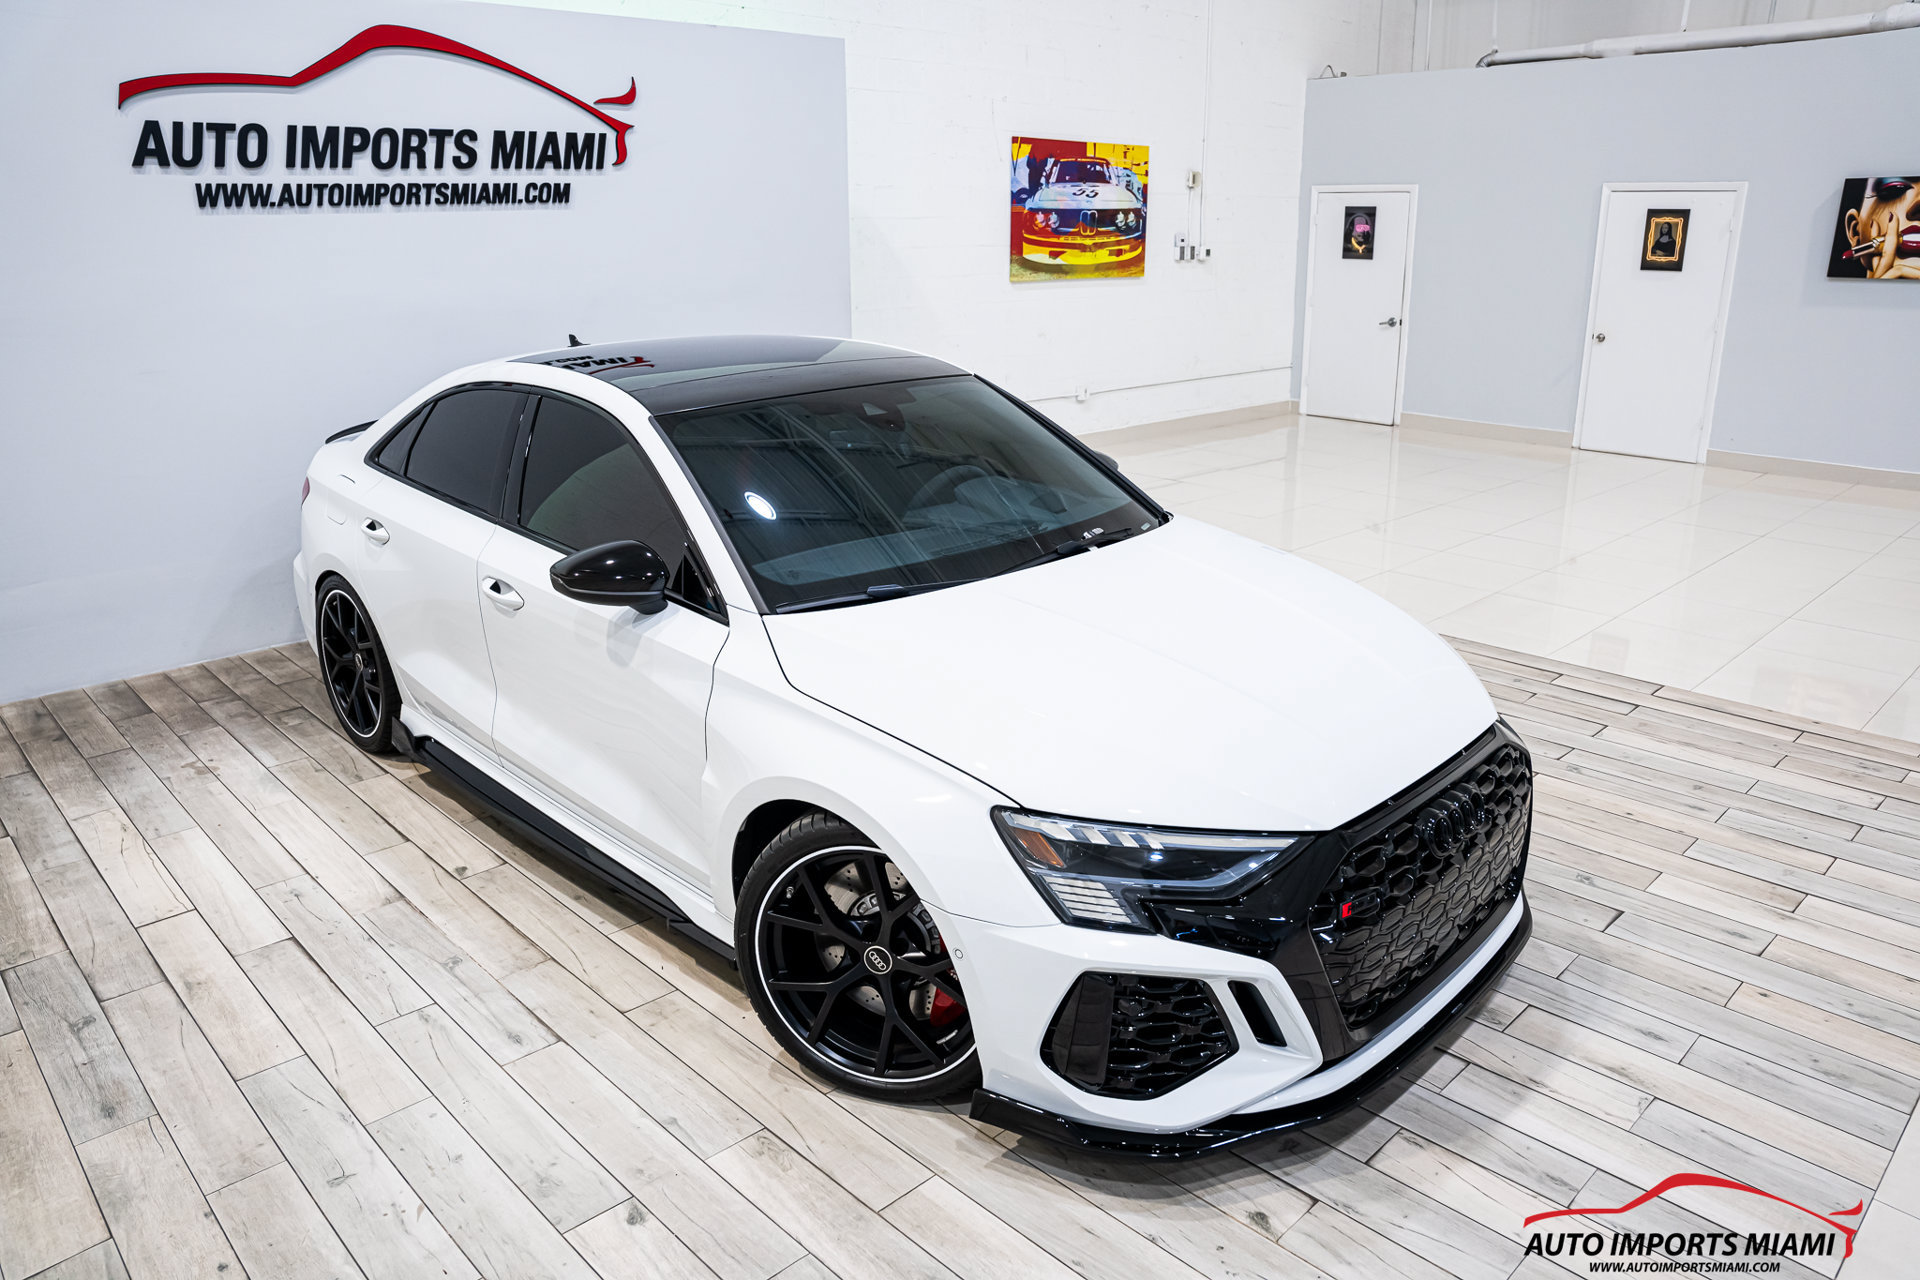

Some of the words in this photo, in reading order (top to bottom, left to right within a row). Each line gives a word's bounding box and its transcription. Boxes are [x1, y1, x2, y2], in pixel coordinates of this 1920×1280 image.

[132, 120, 268, 169] AUTO
[285, 125, 478, 170] IMPORTS
[490, 130, 607, 170] MIAMI
[195, 182, 570, 208] WWW.AUTOIMPORTSMIAMI.COM
[1072, 187, 1099, 198] 55
